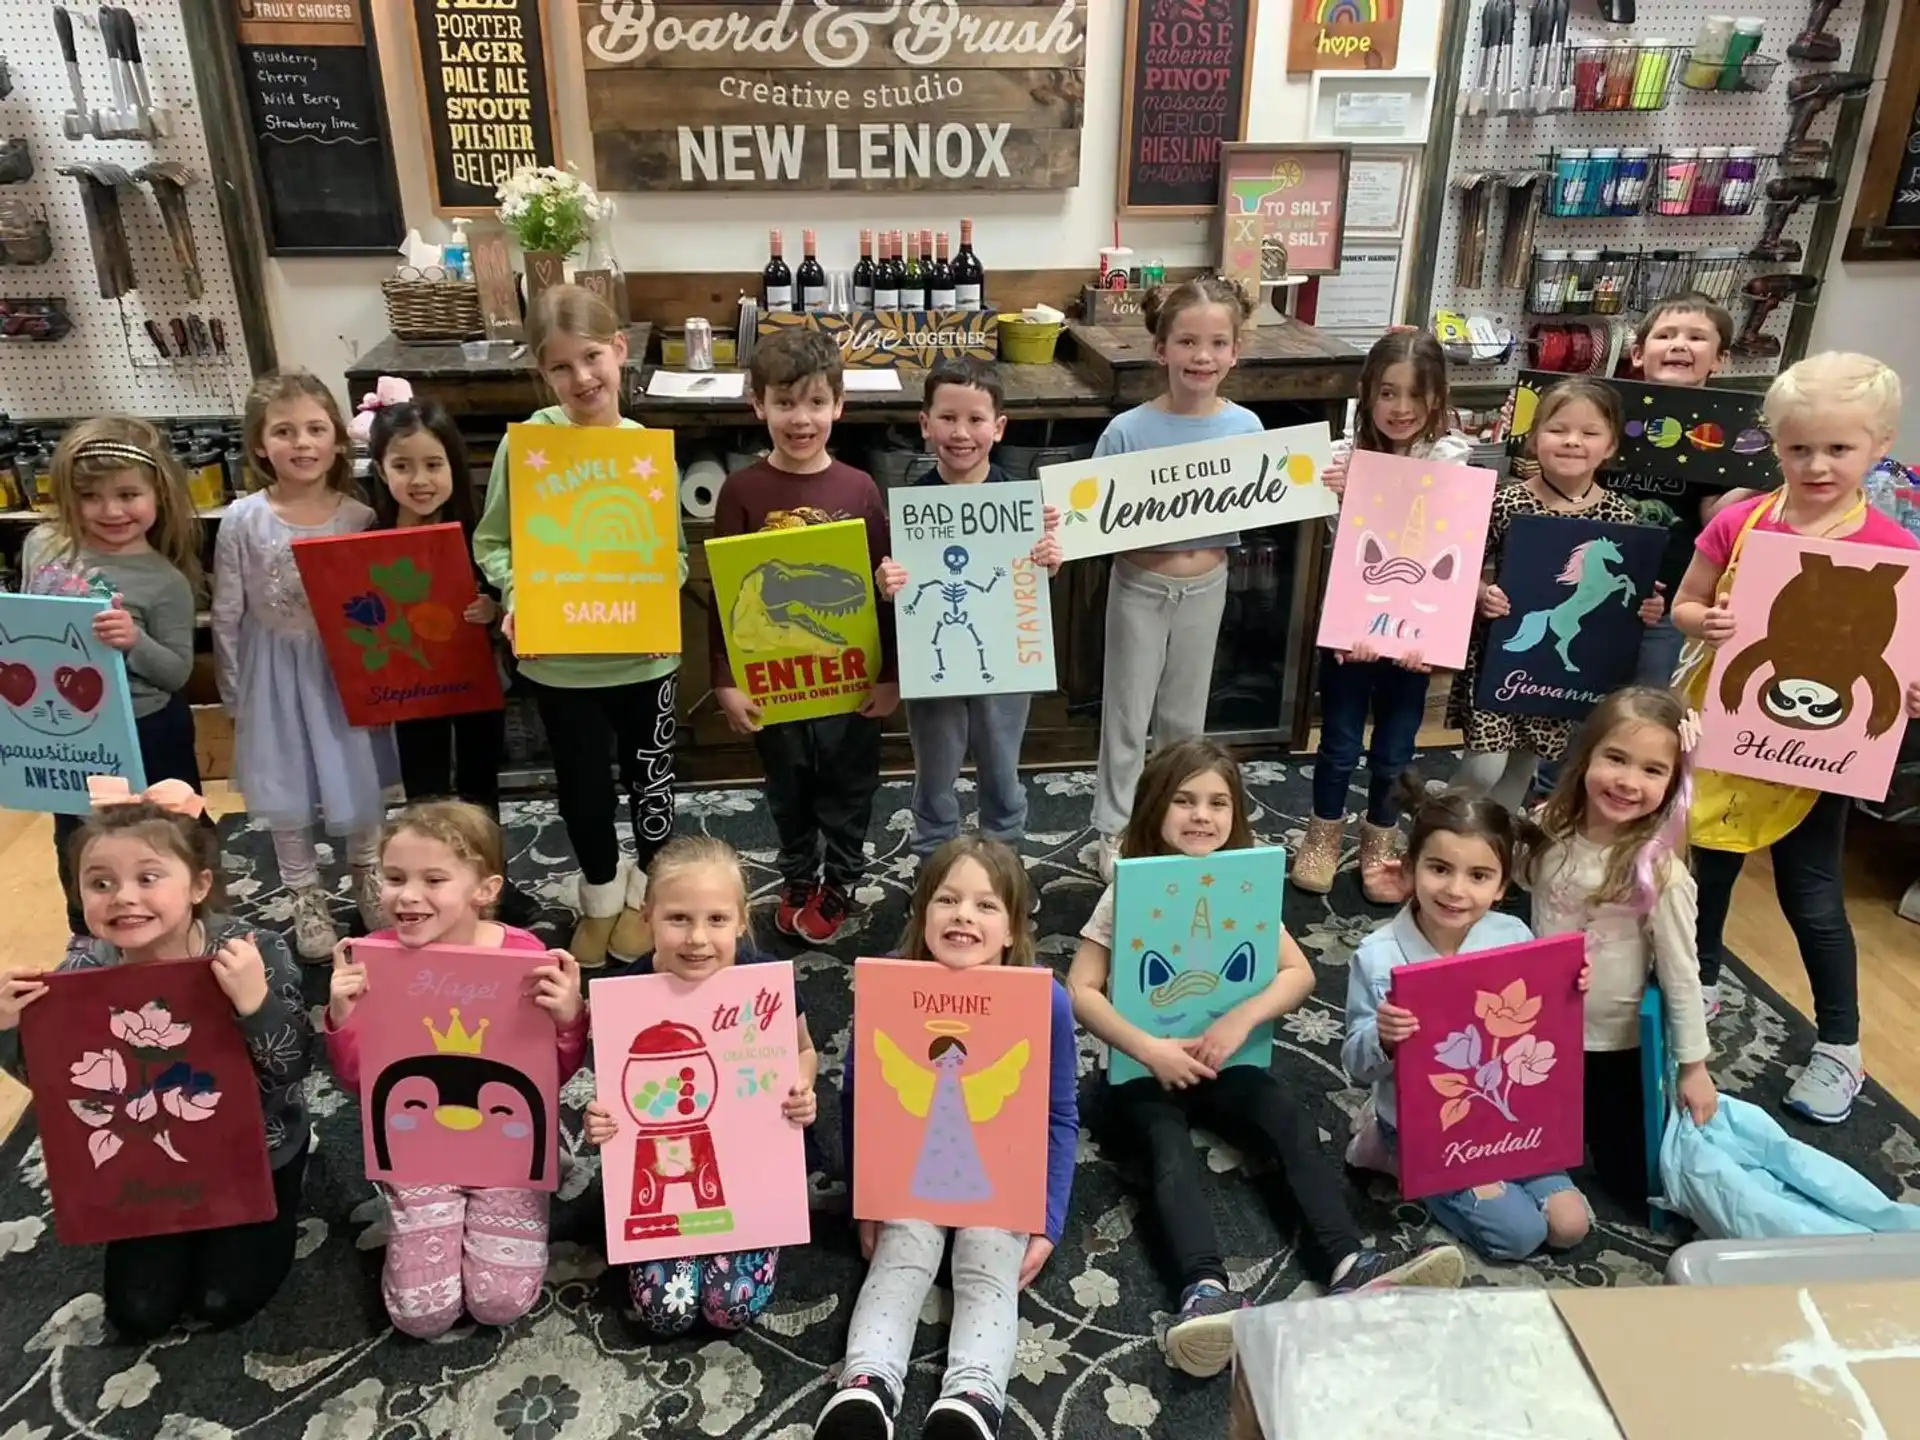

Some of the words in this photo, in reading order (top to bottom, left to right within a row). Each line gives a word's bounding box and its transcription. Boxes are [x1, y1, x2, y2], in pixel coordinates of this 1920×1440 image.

[253, 2, 293, 18] TRULY
[297, 3, 353, 19] CHOICES
[435, 14, 523, 39] PORTER
[587, 0, 798, 63] Board
[892, 0, 1083, 65] Brush
[252, 51, 318, 71] Blueberry
[438, 41, 526, 64] LAGER
[1144, 46, 1233, 66] cabernet
[257, 69, 308, 87] Cherry
[441, 67, 490, 93] PALE
[495, 67, 529, 94] ALE
[719, 74, 850, 109] creative
[863, 71, 963, 109] studio
[1144, 68, 1231, 92] PINOT
[261, 91, 296, 105] Wild
[302, 93, 341, 110] Berry
[446, 97, 532, 121] STOUT
[1141, 112, 1228, 135] MERLOT
[448, 123, 536, 150] PILSNER
[677, 123, 806, 182] NEW
[825, 122, 1012, 180] LENOX
[1263, 201, 1286, 216] TO
[1290, 200, 1332, 216] SALT
[1288, 231, 1330, 247] SALT
[907, 331, 986, 346] TOGETHER
[534, 457, 621, 500] TRAVEL
[1150, 464, 1181, 486] ICE
[1185, 457, 1232, 480] COLD
[1099, 453, 1288, 535] lemonade
[903, 504, 954, 526] BAD
[961, 500, 1035, 535] BONE
[905, 526, 925, 541] TO
[929, 525, 956, 539] THE
[562, 599, 637, 624] SARAH
[1012, 556, 1043, 667] STAVROS
[744, 647, 868, 696] ENTER
[772, 691, 807, 705] YOUR
[810, 685, 840, 699] OWN
[0, 742, 122, 774] pawsitively
[1734, 730, 1858, 775] Holland
[912, 990, 992, 1016] DAPHNE
[1441, 1126, 1543, 1168] Kendall
